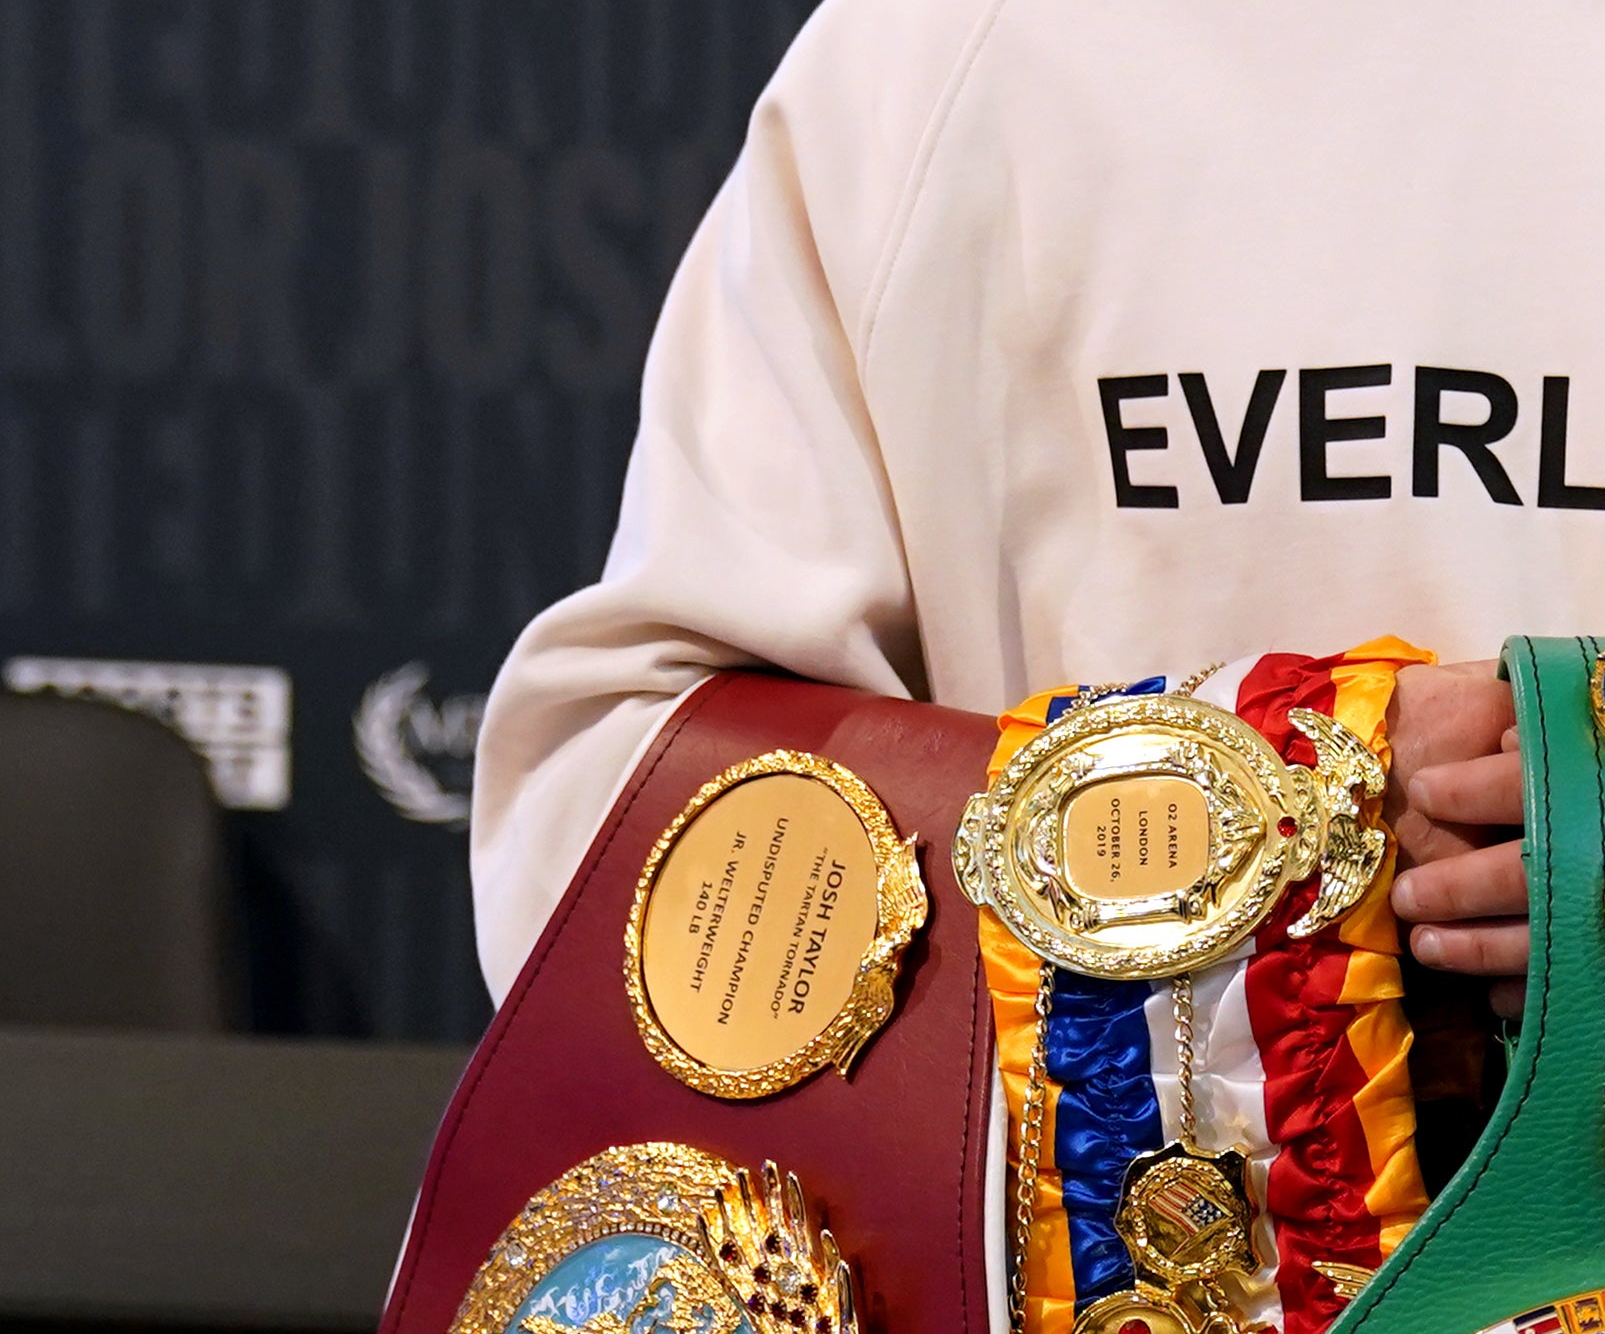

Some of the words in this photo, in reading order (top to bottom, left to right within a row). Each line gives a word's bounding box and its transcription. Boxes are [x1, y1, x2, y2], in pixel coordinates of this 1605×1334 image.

[730, 830, 748, 854] JR.
[1096, 825, 1107, 858] 2019
[1110, 798, 1121, 860] OCTOBER
[1138, 810, 1149, 867] LONDON
[1167, 825, 1178, 870] ARENA
[694, 880, 714, 912] 140
[747, 816, 790, 926] UNDISPUTED
[817, 859, 847, 920] JOSH
[688, 914, 702, 935] LB
[688, 859, 740, 993] WELTERWEIGHT
[793, 882, 817, 938] TARTAN
[716, 929, 755, 1026] CHAMPION
[788, 927, 828, 1015] TAYLOR
